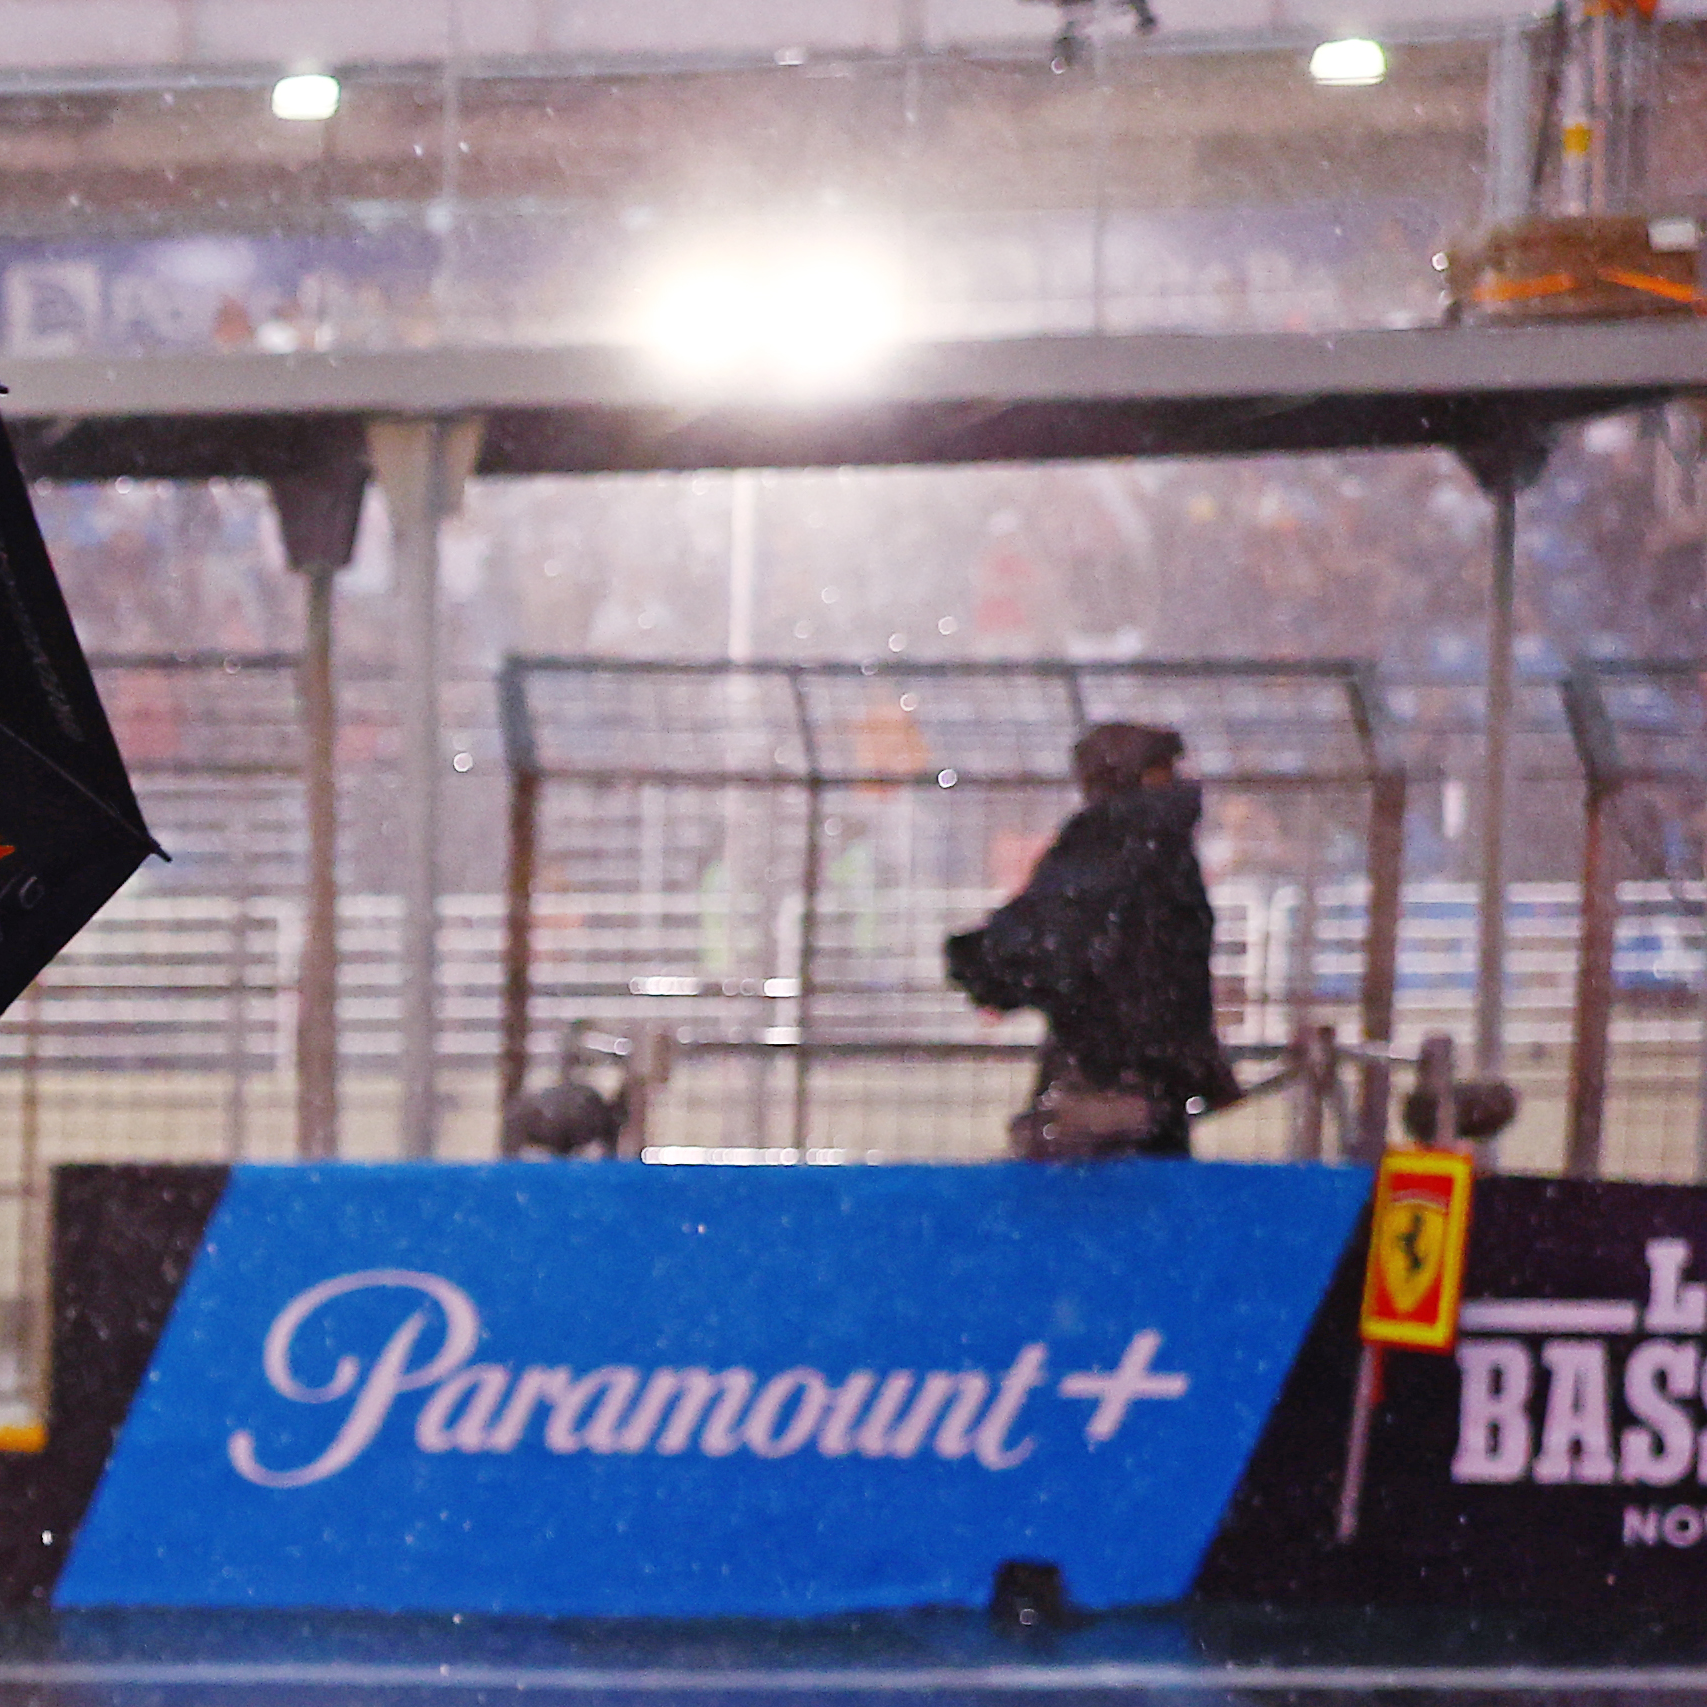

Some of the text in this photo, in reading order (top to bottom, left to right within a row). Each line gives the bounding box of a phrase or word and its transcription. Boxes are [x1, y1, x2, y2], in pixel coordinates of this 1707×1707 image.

[227, 1267, 1189, 1489] Paramount+
[1451, 1338, 1707, 1486] BAS
[1622, 1505, 1707, 1548] NO
